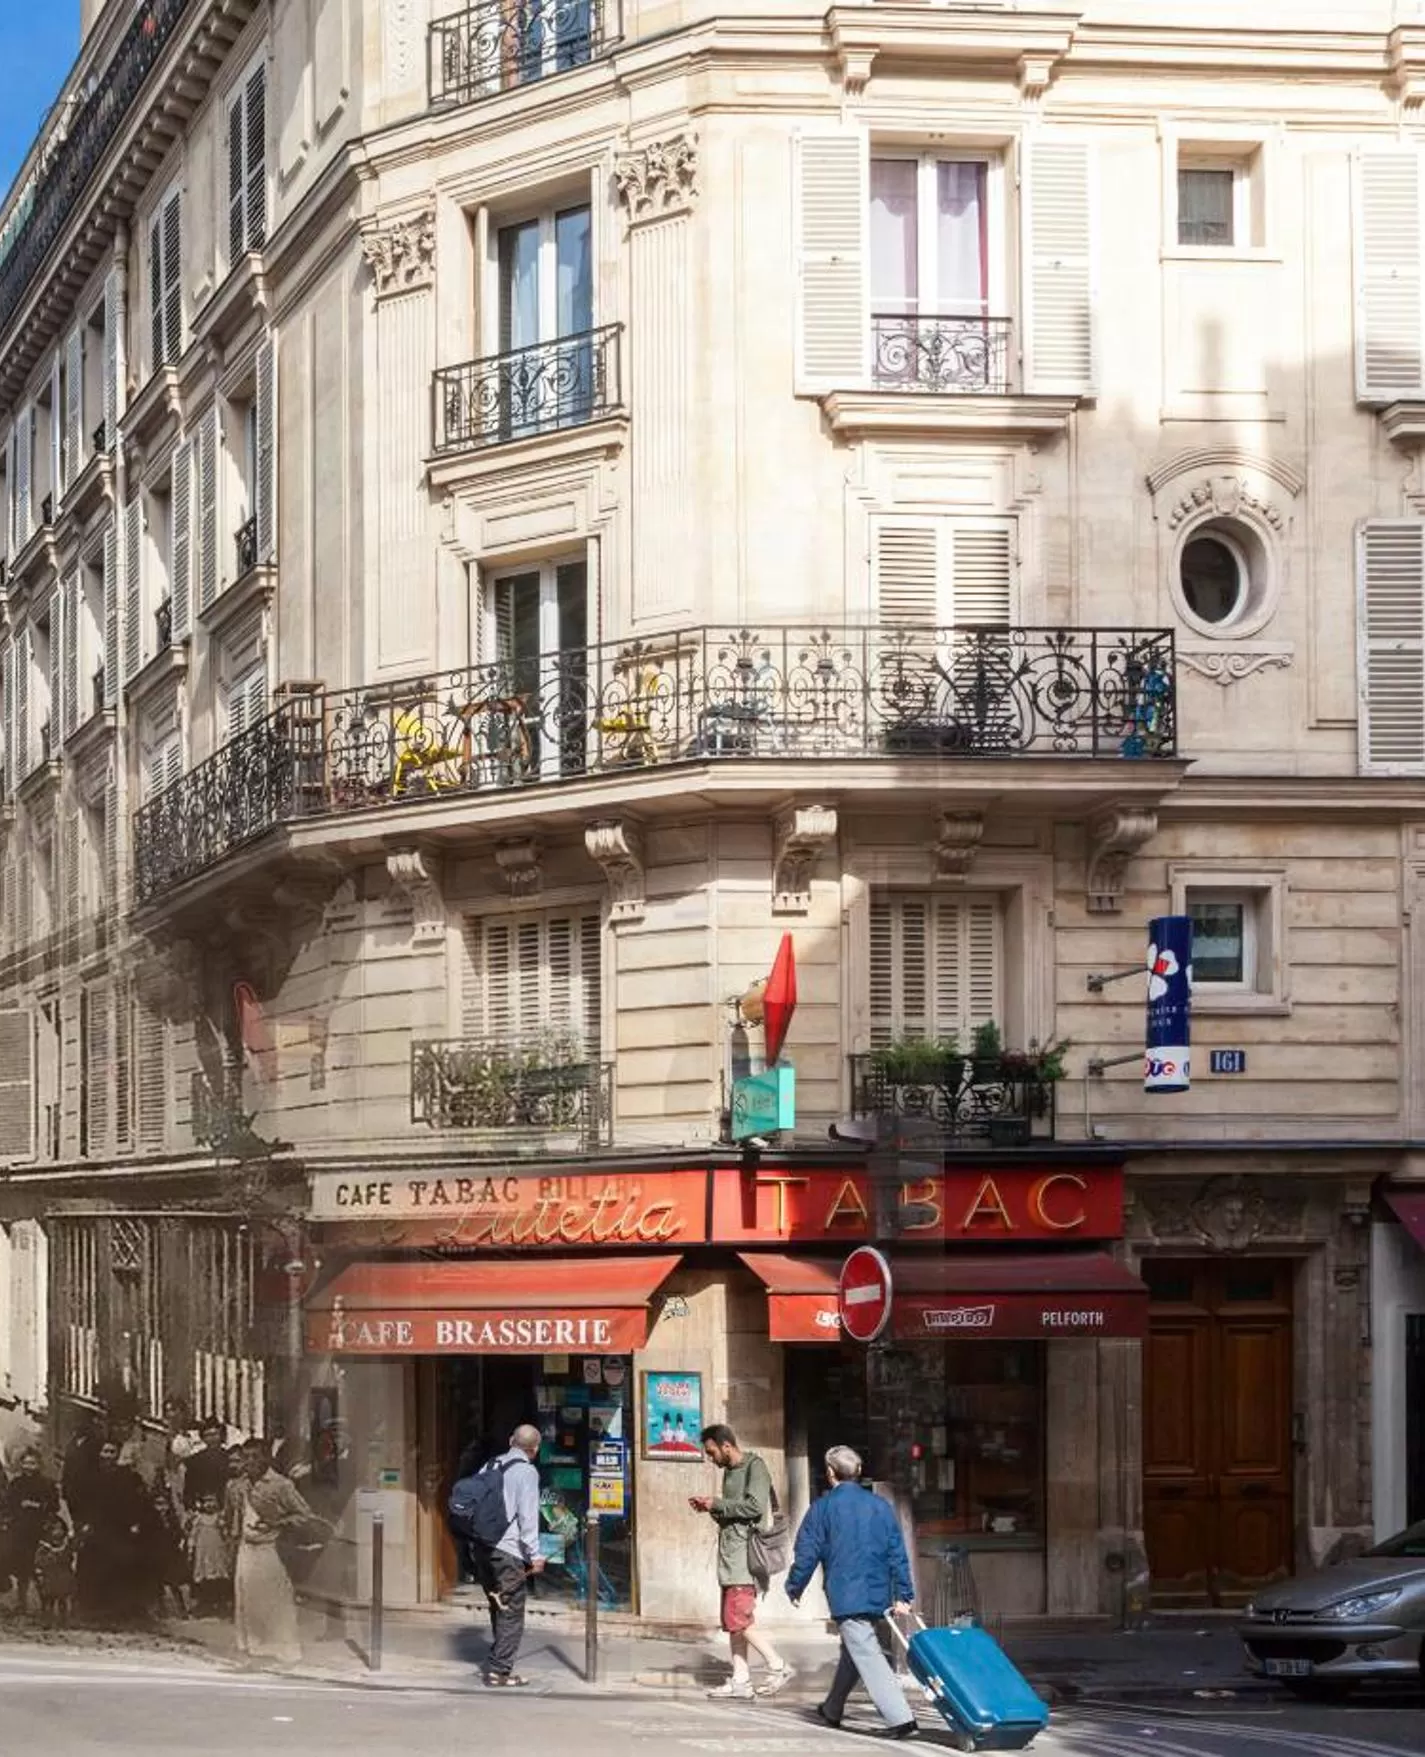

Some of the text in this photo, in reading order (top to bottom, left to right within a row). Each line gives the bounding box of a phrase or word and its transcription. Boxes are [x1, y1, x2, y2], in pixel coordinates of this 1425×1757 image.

[1215, 1051, 1240, 1071] 161
[335, 1181, 393, 1206] CAFE
[408, 1176, 520, 1205] TABAC
[755, 1174, 1088, 1235] TABAC
[1041, 1311, 1104, 1326] PELFORTH
[340, 1319, 612, 1346] CAFE BRASSERIE
